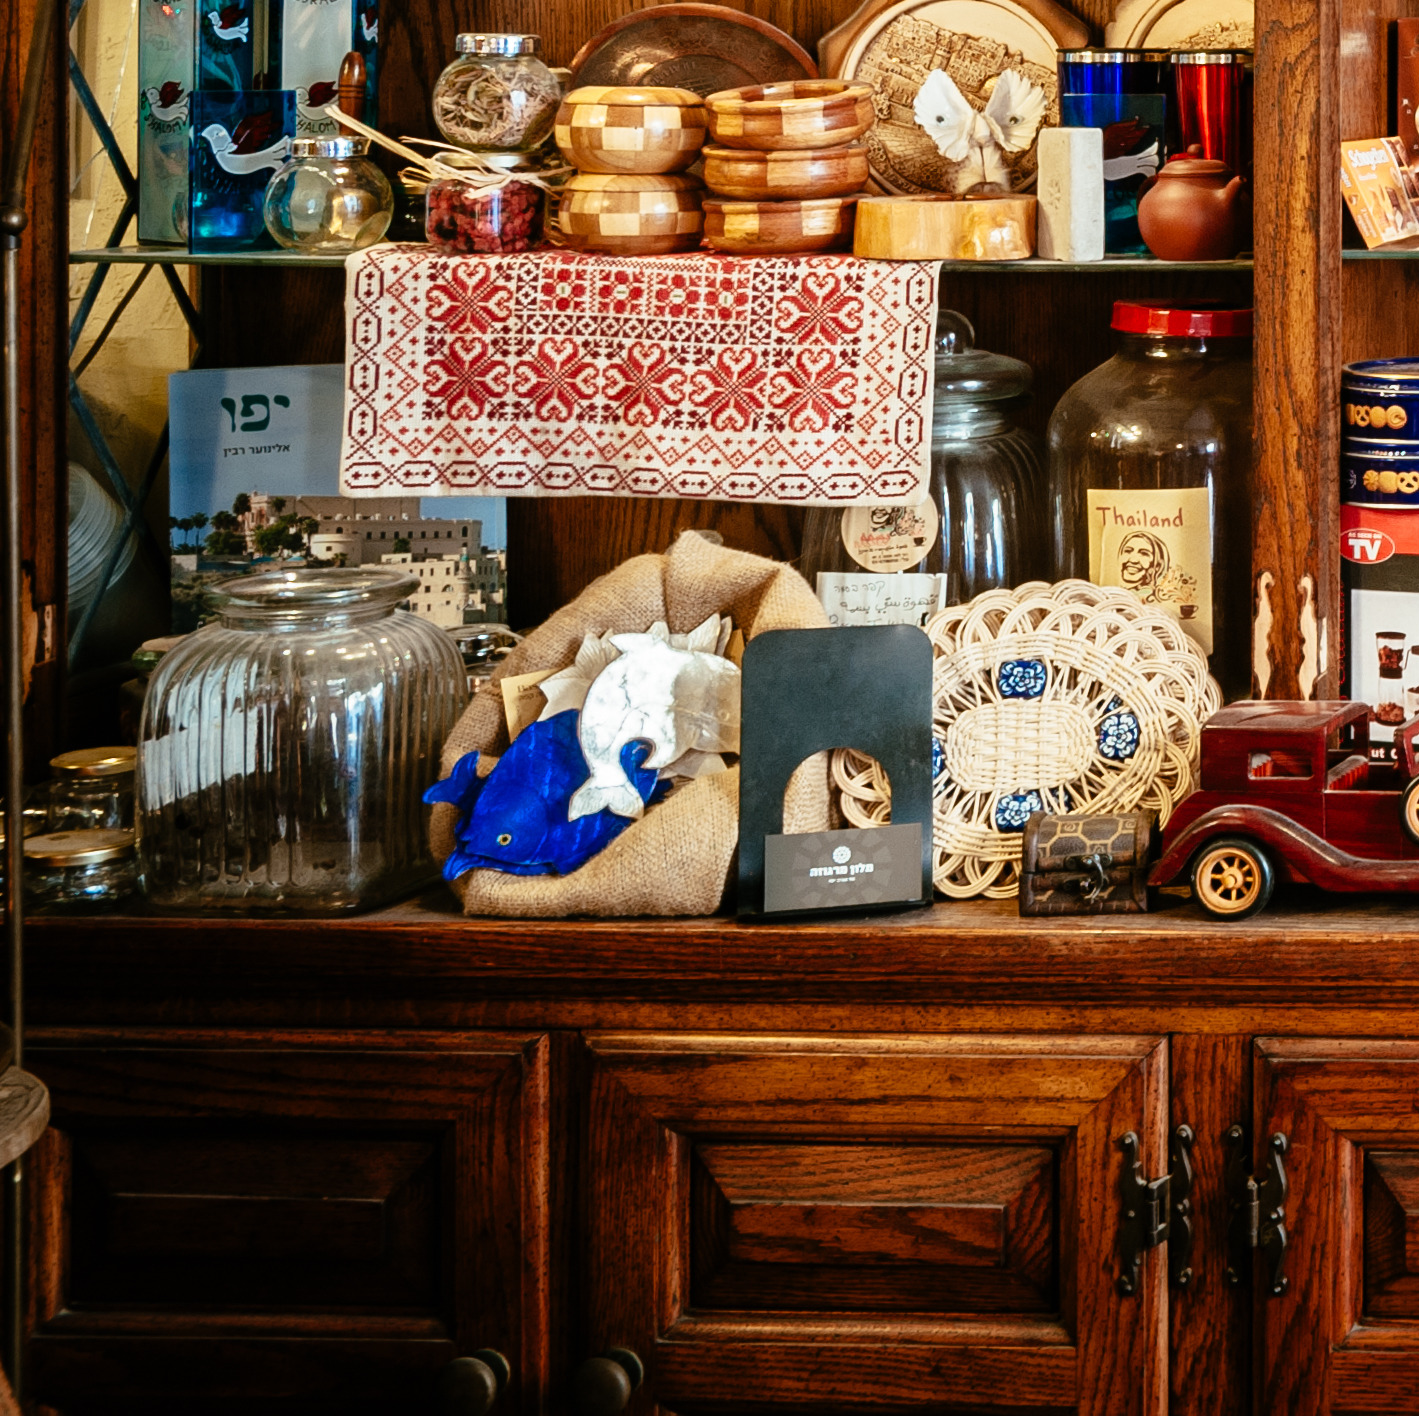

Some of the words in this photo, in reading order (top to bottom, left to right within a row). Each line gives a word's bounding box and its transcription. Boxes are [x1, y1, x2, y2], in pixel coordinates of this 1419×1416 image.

[221, 393, 291, 433] יפו
[223, 446, 246, 458] רבין
[249, 443, 291, 455] אלינוער
[1096, 506, 1184, 528] Thailand
[1348, 539, 1382, 561] TV
